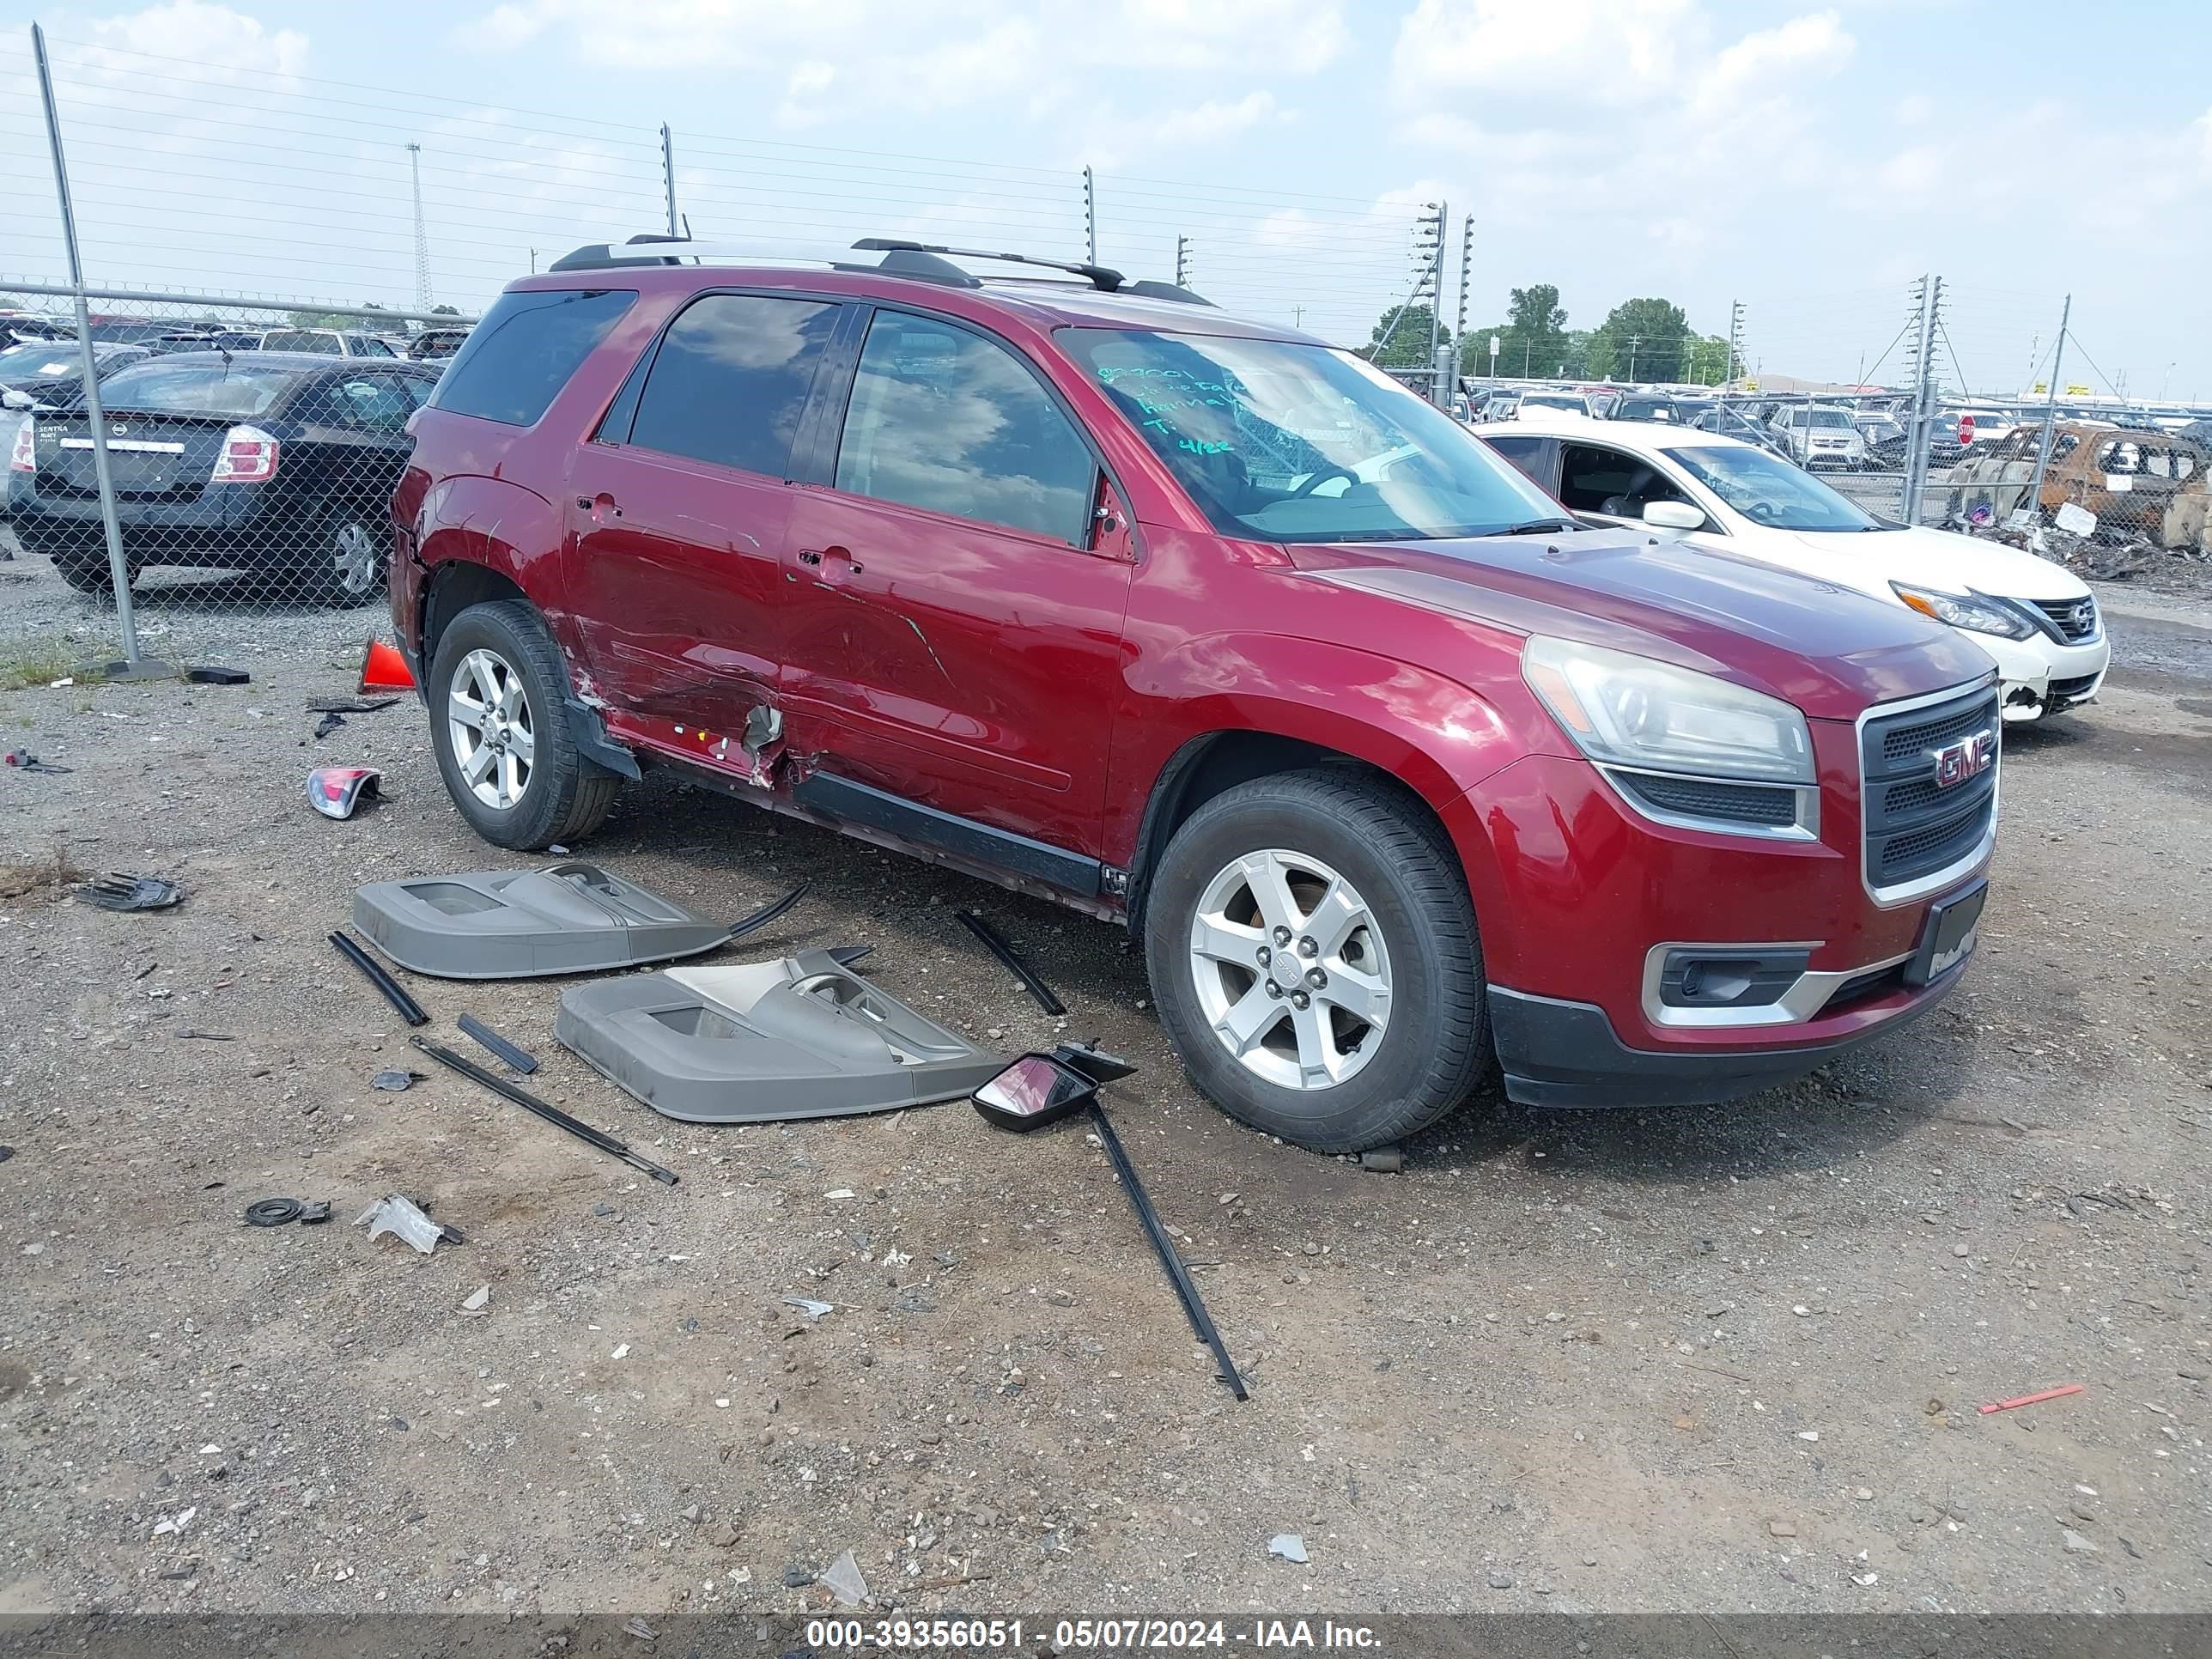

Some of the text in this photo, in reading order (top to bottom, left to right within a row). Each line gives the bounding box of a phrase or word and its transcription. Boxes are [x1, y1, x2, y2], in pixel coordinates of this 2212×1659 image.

[1960, 424, 1974, 436] STOP
[1935, 729, 1992, 787] GMC
[1276, 956, 1298, 982] GMC
